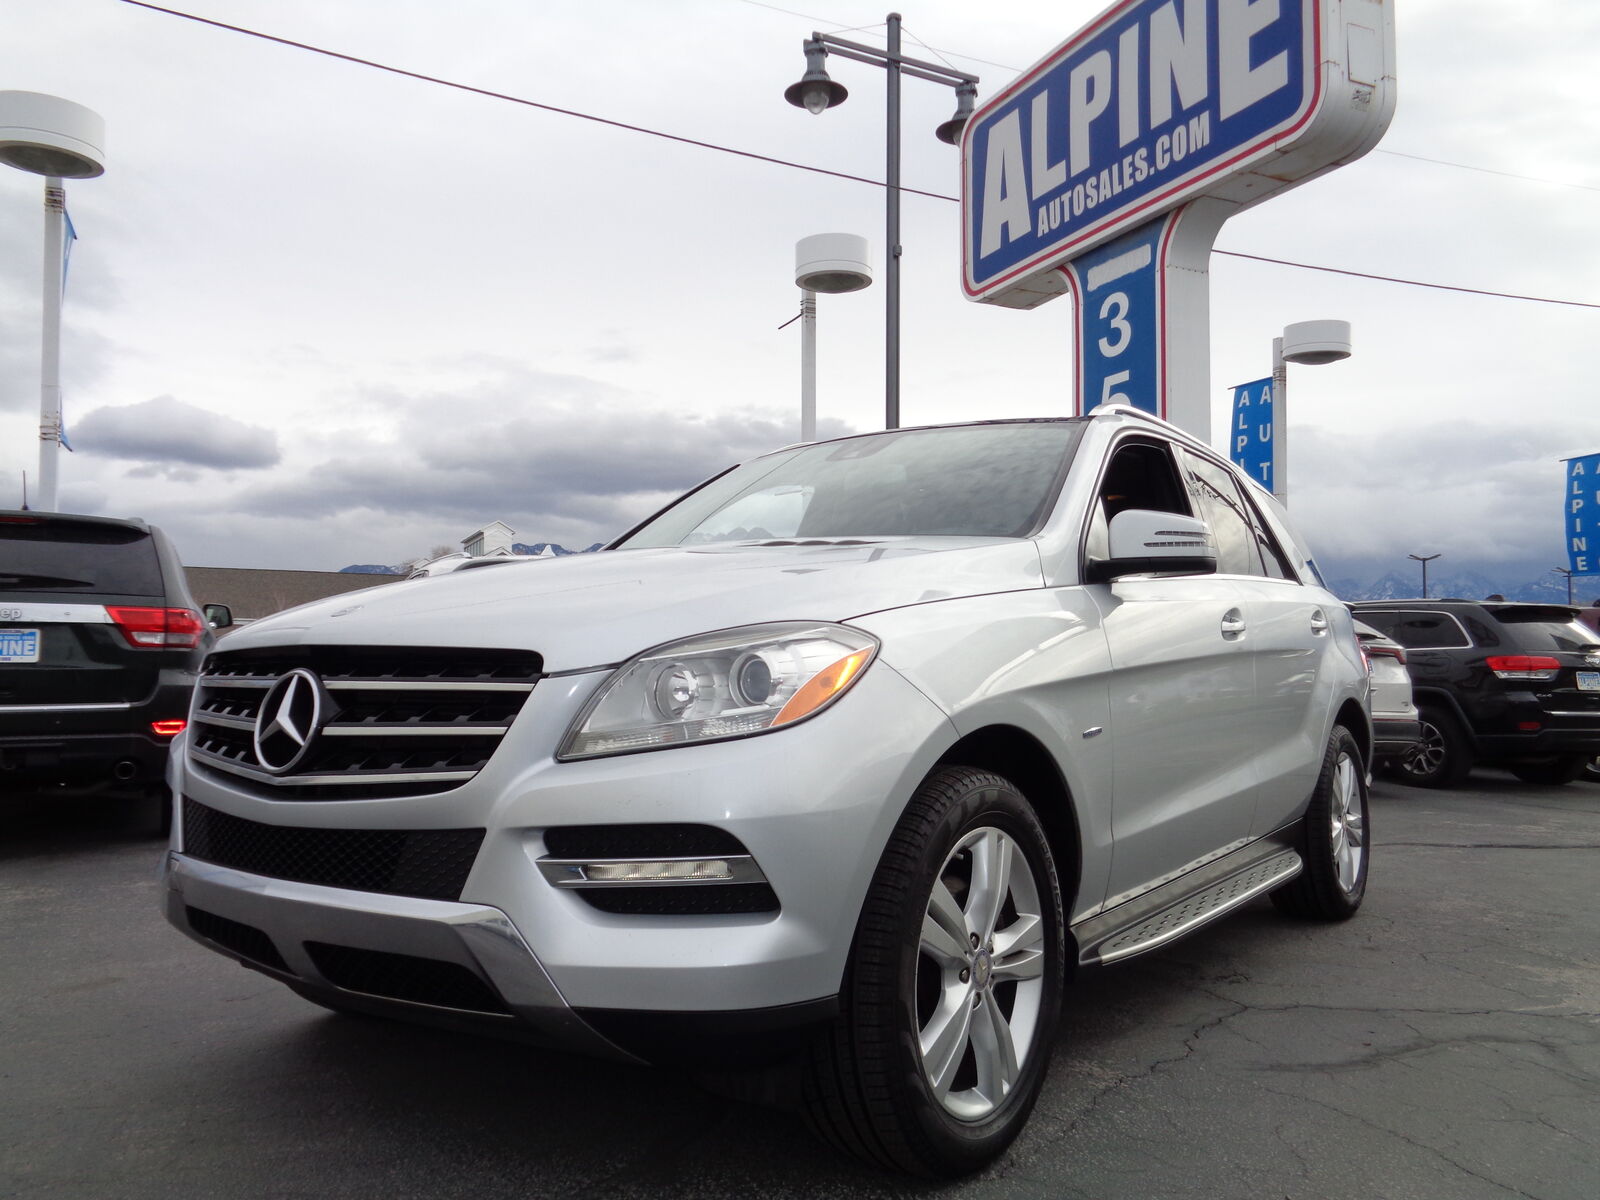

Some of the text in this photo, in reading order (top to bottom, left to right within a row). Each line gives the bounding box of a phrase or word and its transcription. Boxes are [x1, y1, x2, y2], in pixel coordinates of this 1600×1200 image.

[980, 0, 1289, 259] ALPINE
[1037, 110, 1210, 238] AUTOSALES.COM
[1571, 461, 1588, 571] ALPINE
